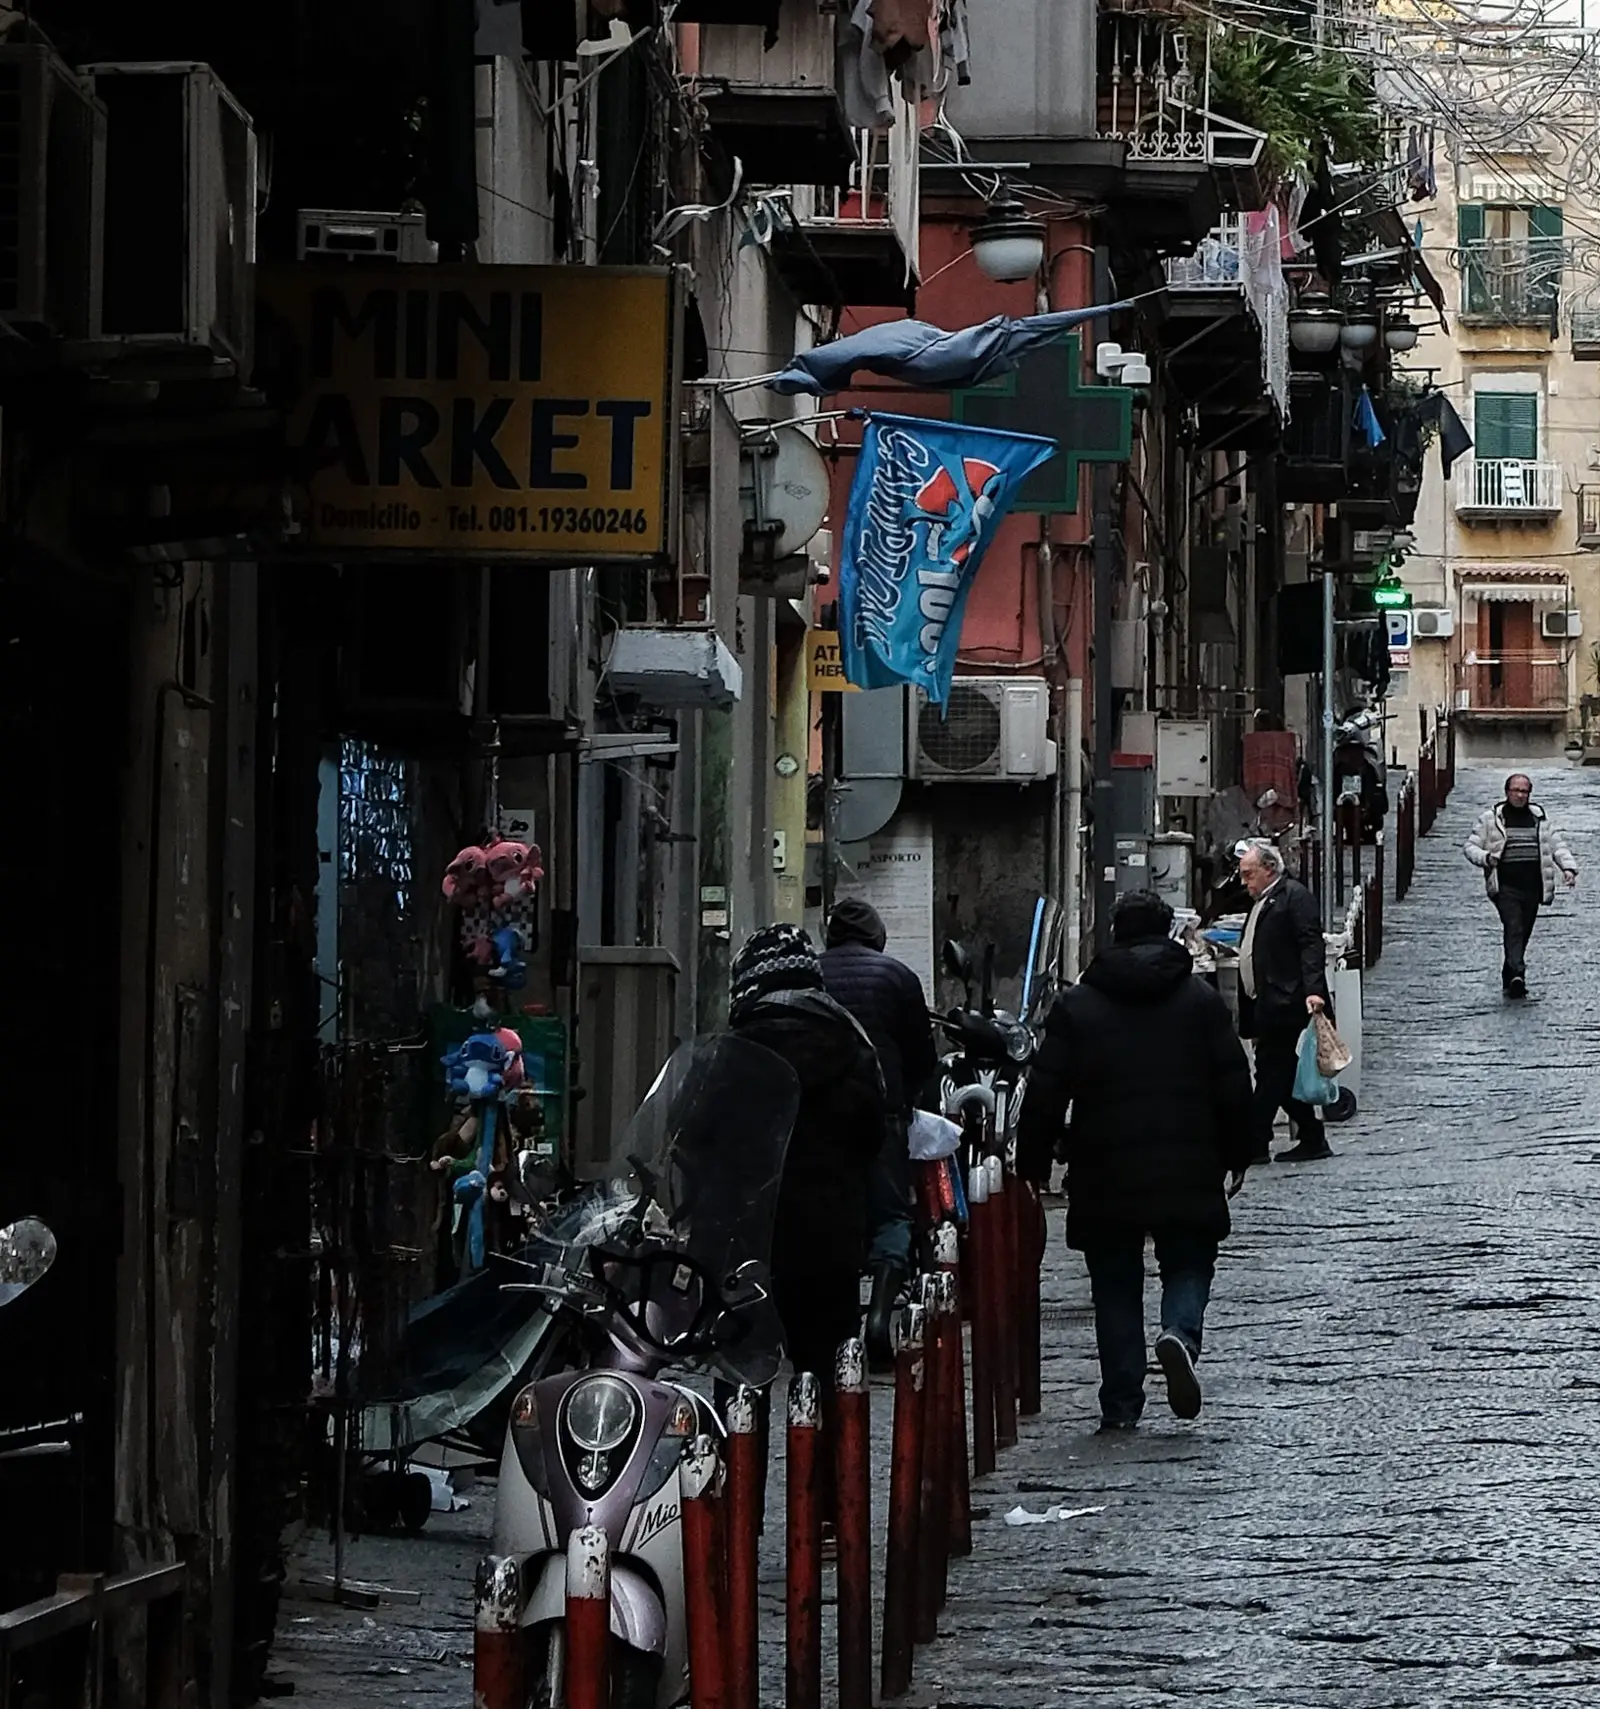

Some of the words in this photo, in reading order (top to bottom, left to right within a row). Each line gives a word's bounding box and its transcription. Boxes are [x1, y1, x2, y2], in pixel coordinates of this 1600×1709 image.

[311, 289, 542, 381] MINI
[304, 393, 652, 491] ARKET
[321, 503, 421, 531] Domicilio
[446, 505, 483, 533] Tel.
[488, 507, 648, 535] 081.19360246
[813, 644, 842, 661] AT
[640, 1502, 679, 1541] Mio
